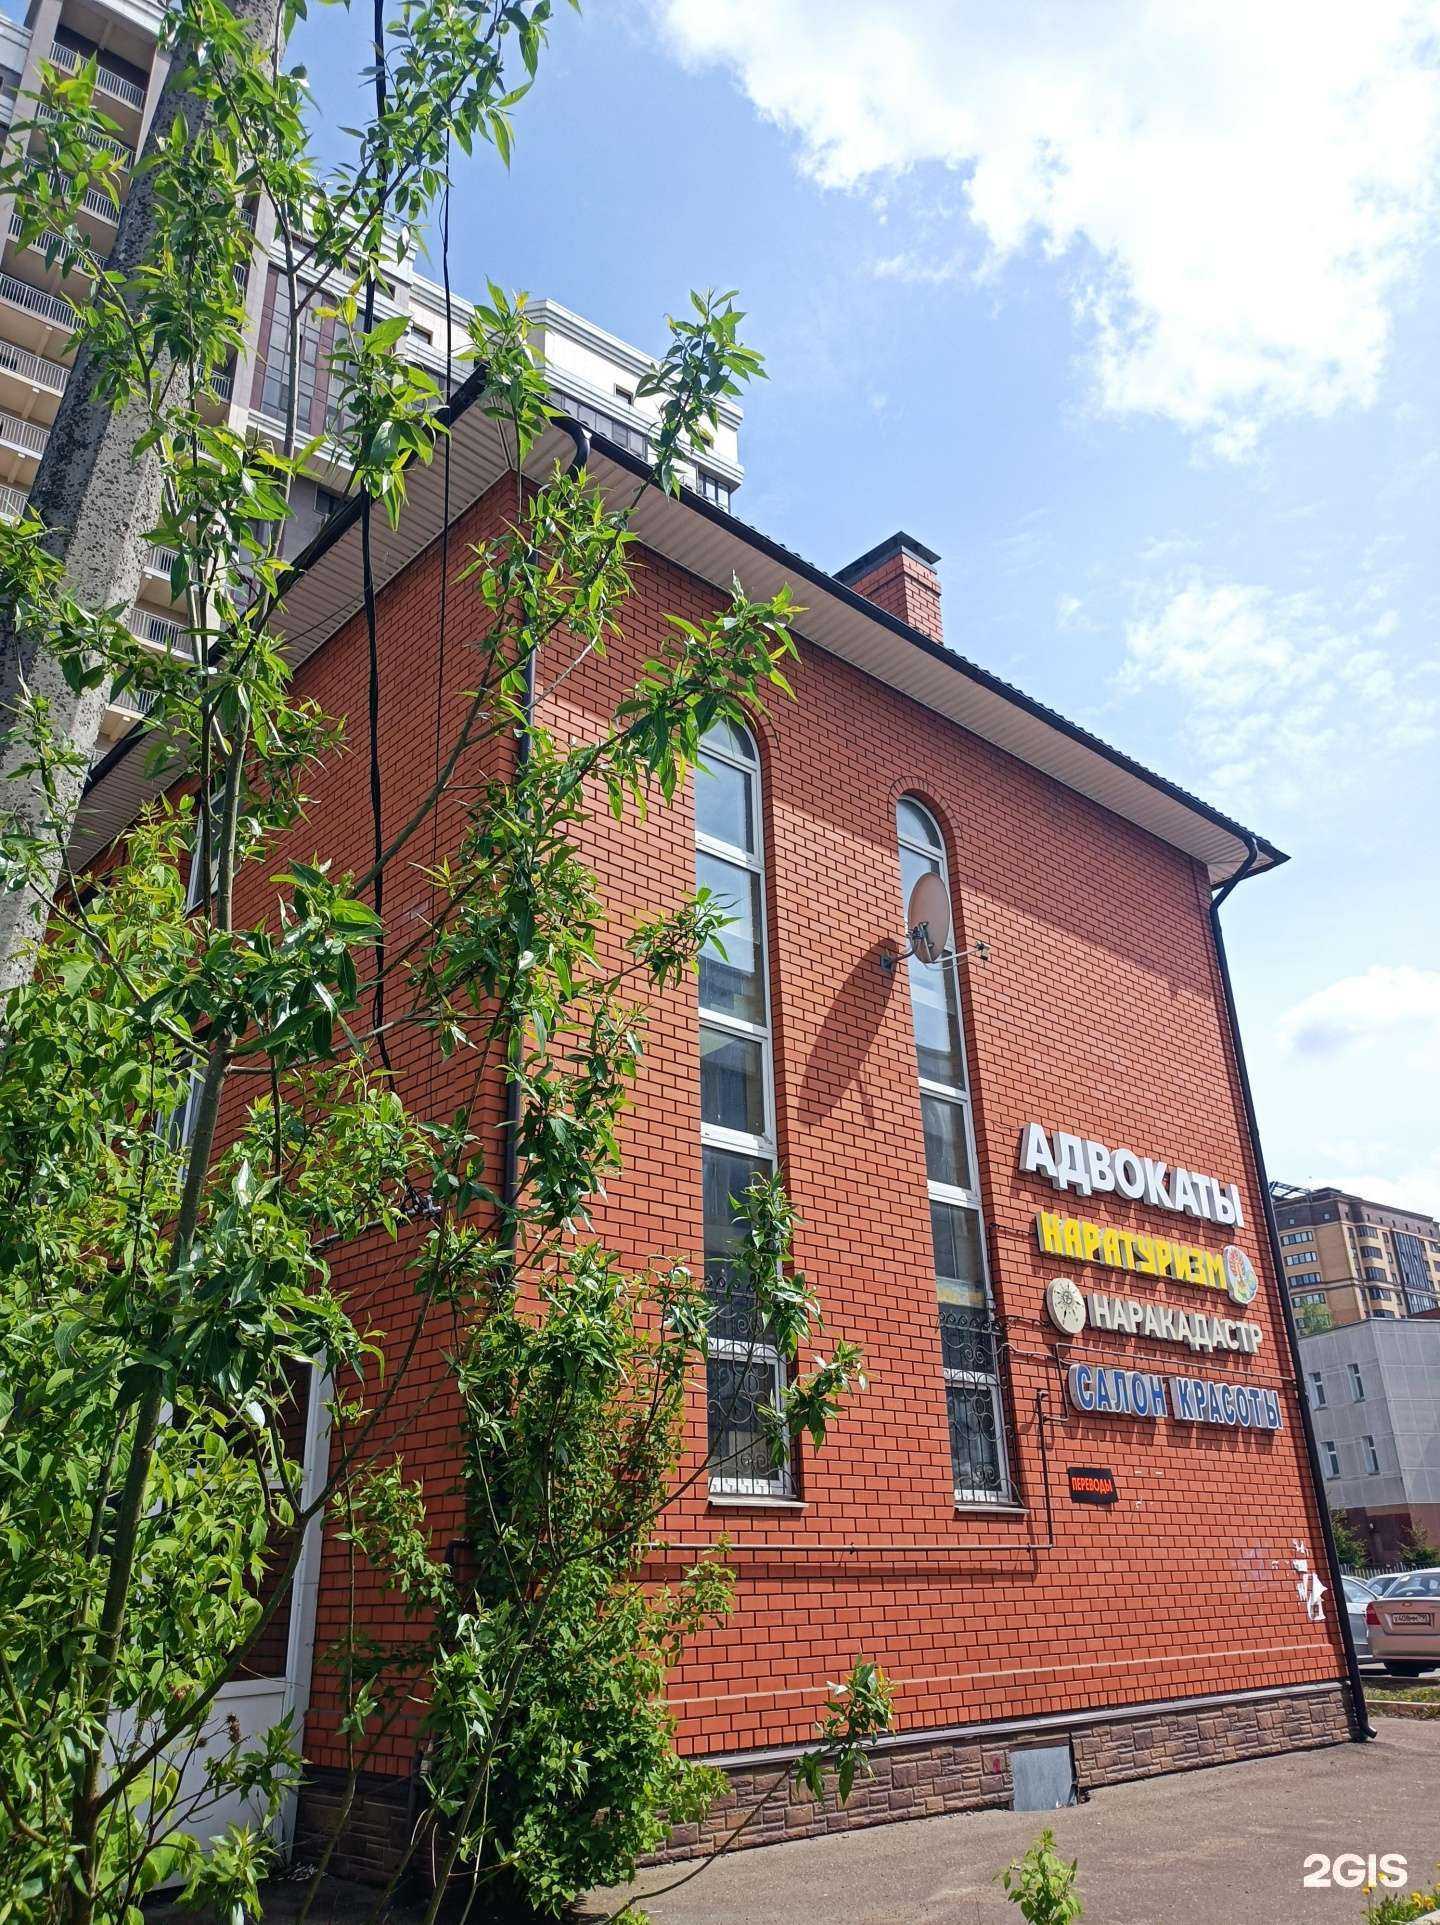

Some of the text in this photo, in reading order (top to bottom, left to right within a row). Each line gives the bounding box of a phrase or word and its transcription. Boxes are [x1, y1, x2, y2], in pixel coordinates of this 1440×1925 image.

[1020, 1122, 1245, 1228] АДВОКАТЫ
[1037, 1211, 1228, 1290] НАРАТУРИЗМ
[1089, 1293, 1263, 1354] НАРАКАДАСТР
[1070, 1364, 1283, 1430] САЛОН КРАСОТЫ
[1071, 1477, 1113, 1495] ПЕРЕВОДЫ
